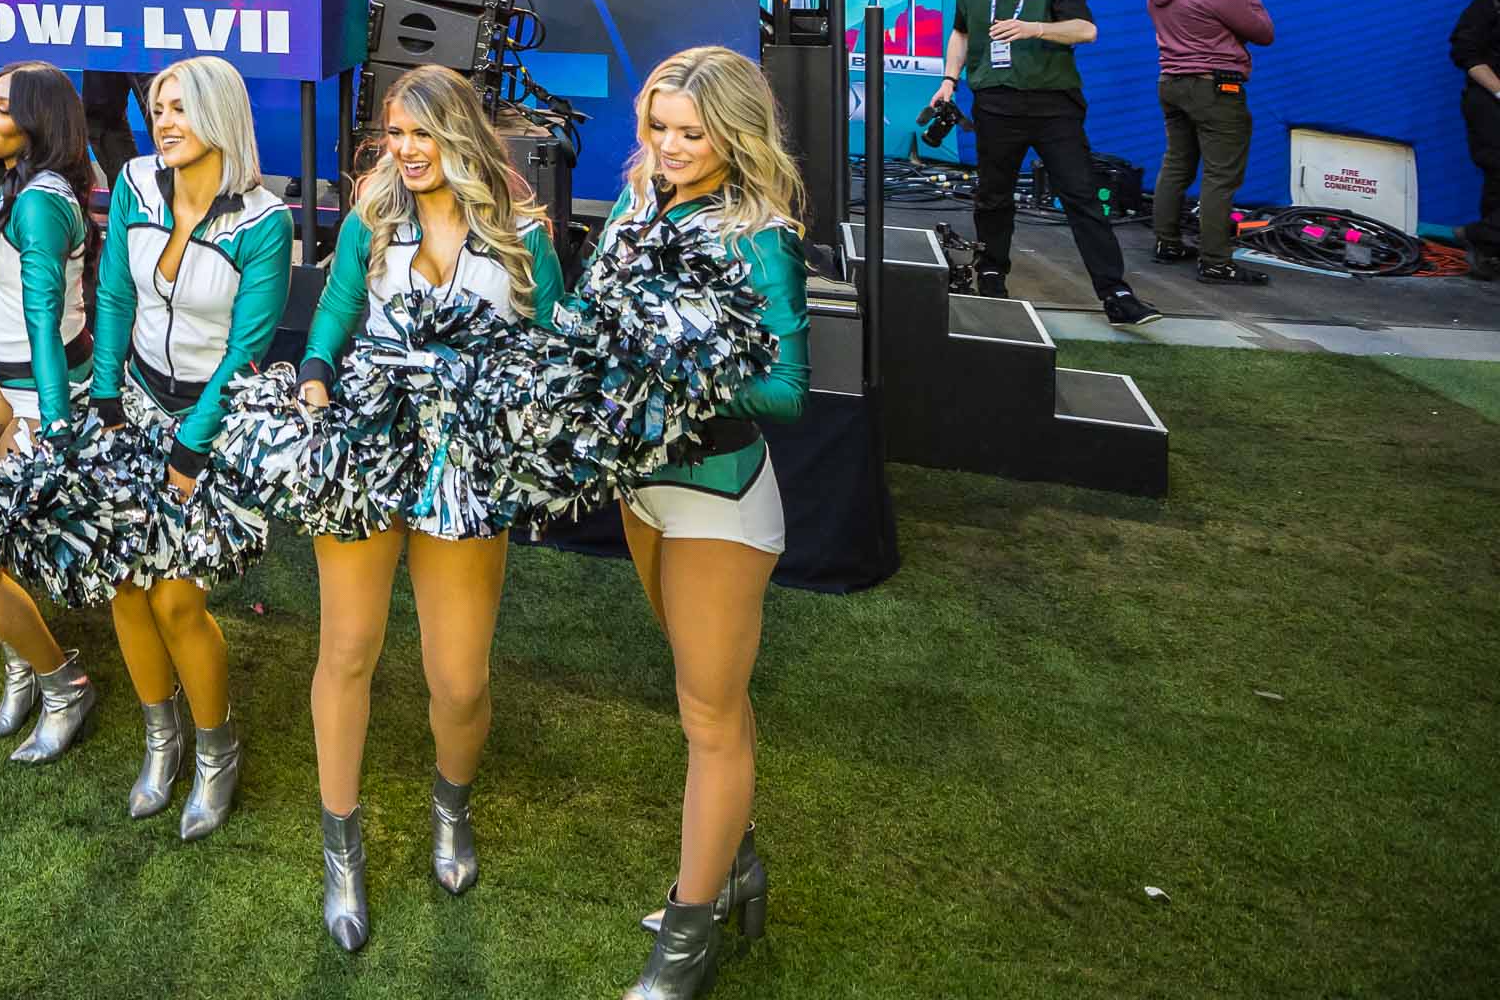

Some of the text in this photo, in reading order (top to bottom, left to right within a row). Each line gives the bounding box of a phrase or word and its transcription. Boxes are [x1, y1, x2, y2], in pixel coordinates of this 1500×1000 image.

[142, 7, 291, 54] LVII
[851, 56, 927, 71] BWL
[1341, 168, 1360, 177] FIRE
[1324, 174, 1378, 186] DEPARTMENT
[1324, 182, 1377, 194] CONNECTION
